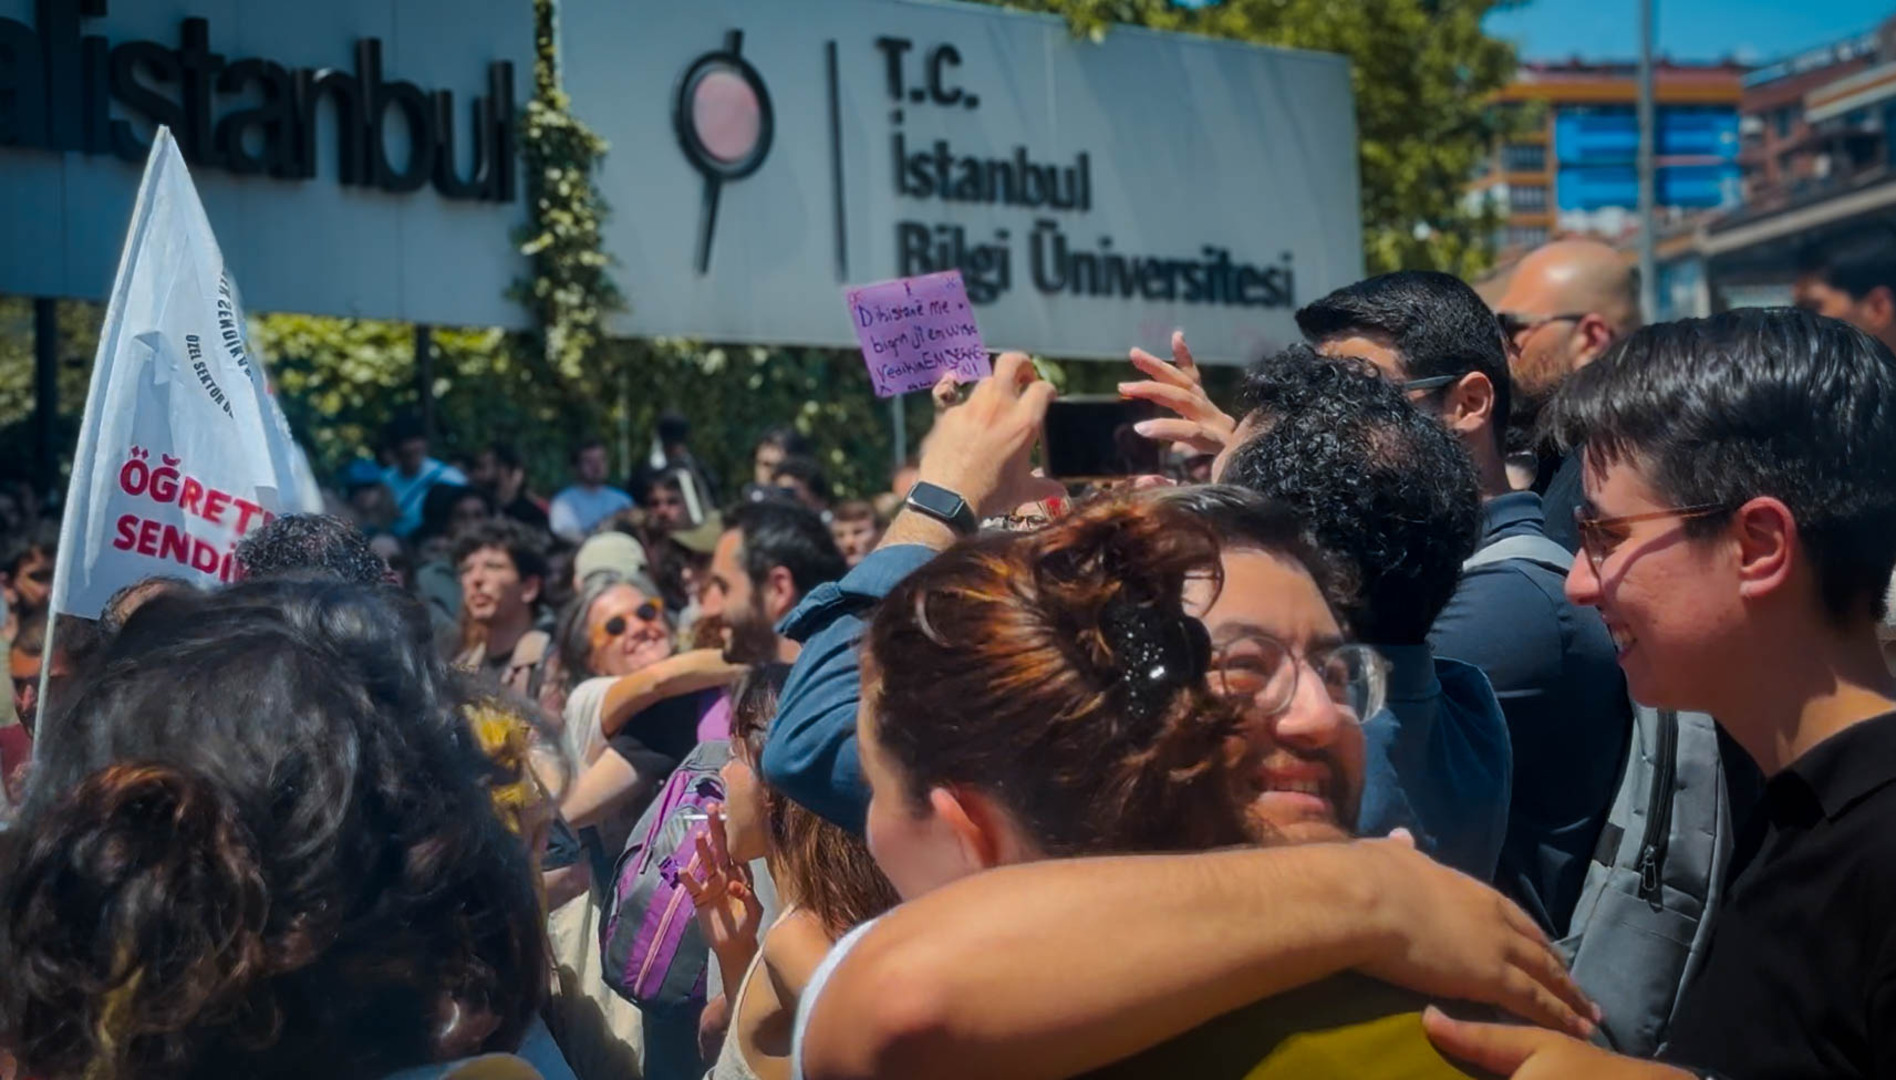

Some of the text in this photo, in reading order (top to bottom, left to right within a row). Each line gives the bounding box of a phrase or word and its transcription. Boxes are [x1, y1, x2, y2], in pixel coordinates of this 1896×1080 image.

[875, 35, 980, 109] T.C.
[889, 109, 1092, 212] İstanbul
[895, 217, 1297, 308] Bilgi Üniversitesi
[119, 445, 277, 535] ÖĞRET
